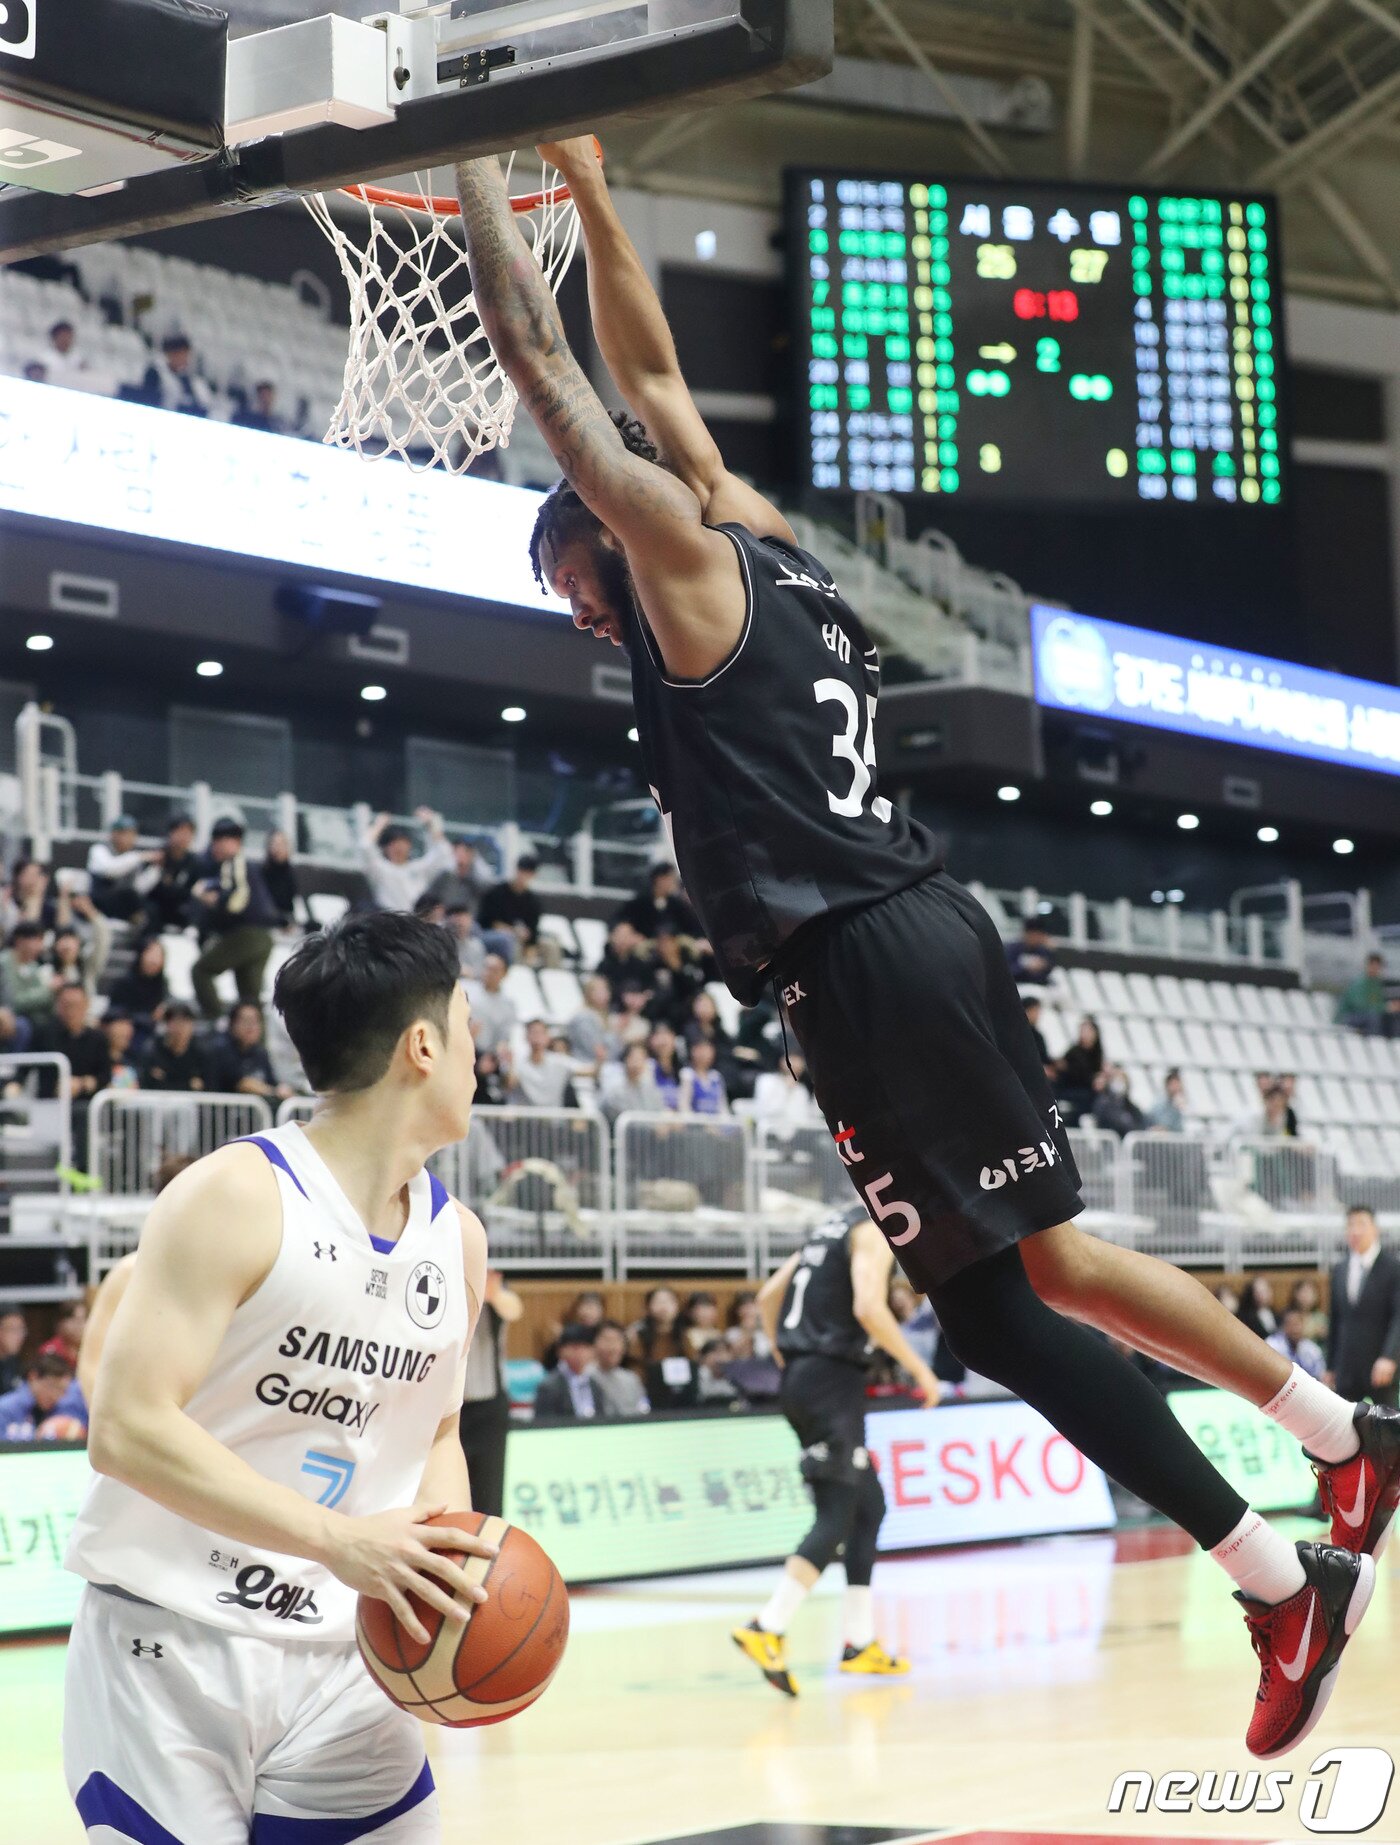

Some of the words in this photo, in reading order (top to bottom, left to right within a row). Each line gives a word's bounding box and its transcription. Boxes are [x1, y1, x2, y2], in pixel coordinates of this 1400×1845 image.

[782, 1266, 813, 1330] 1
[278, 1325, 437, 1383] SAMSUNG
[255, 1372, 380, 1438] Galaxy
[300, 1449, 357, 1510] 7
[1216, 1519, 1263, 1560] Supreme
[215, 1563, 325, 1625] 오예스
